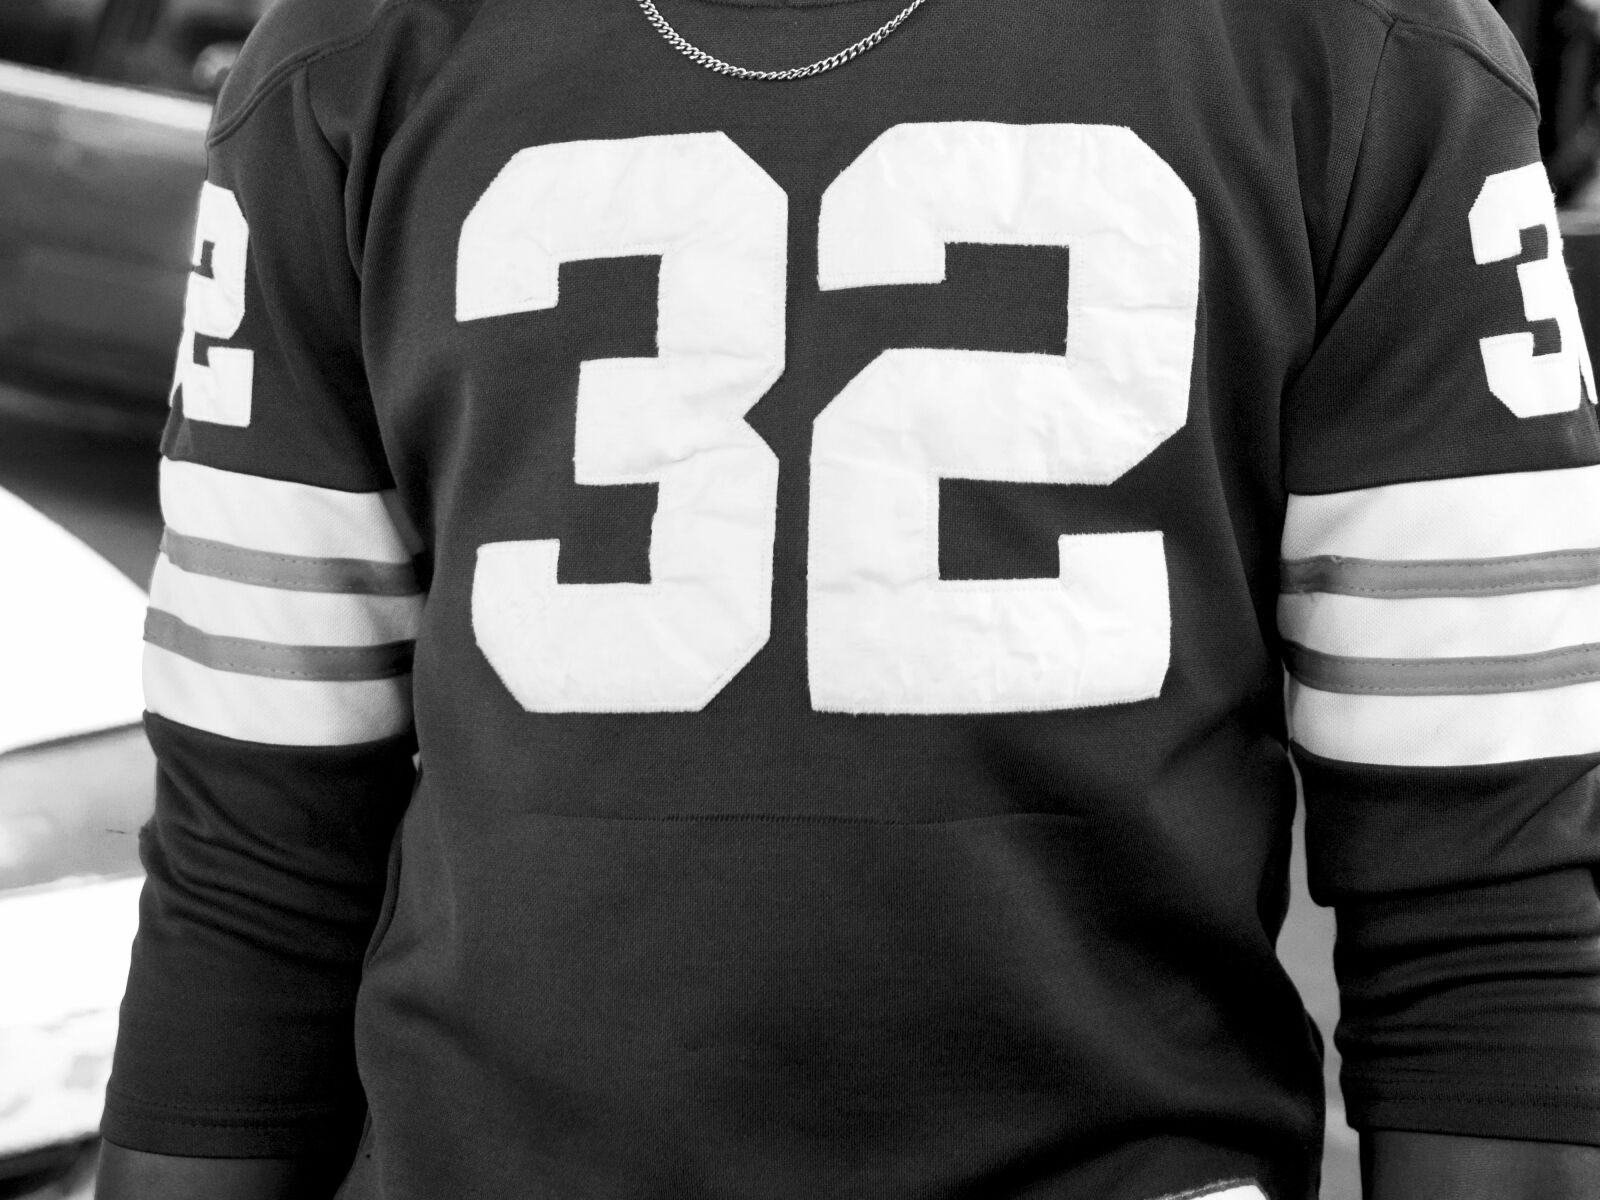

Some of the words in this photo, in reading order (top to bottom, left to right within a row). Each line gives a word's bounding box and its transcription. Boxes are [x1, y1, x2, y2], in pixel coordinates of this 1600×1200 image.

[168, 180, 255, 429] 2
[455, 121, 1201, 716] 32
[1467, 161, 1598, 419] 3
